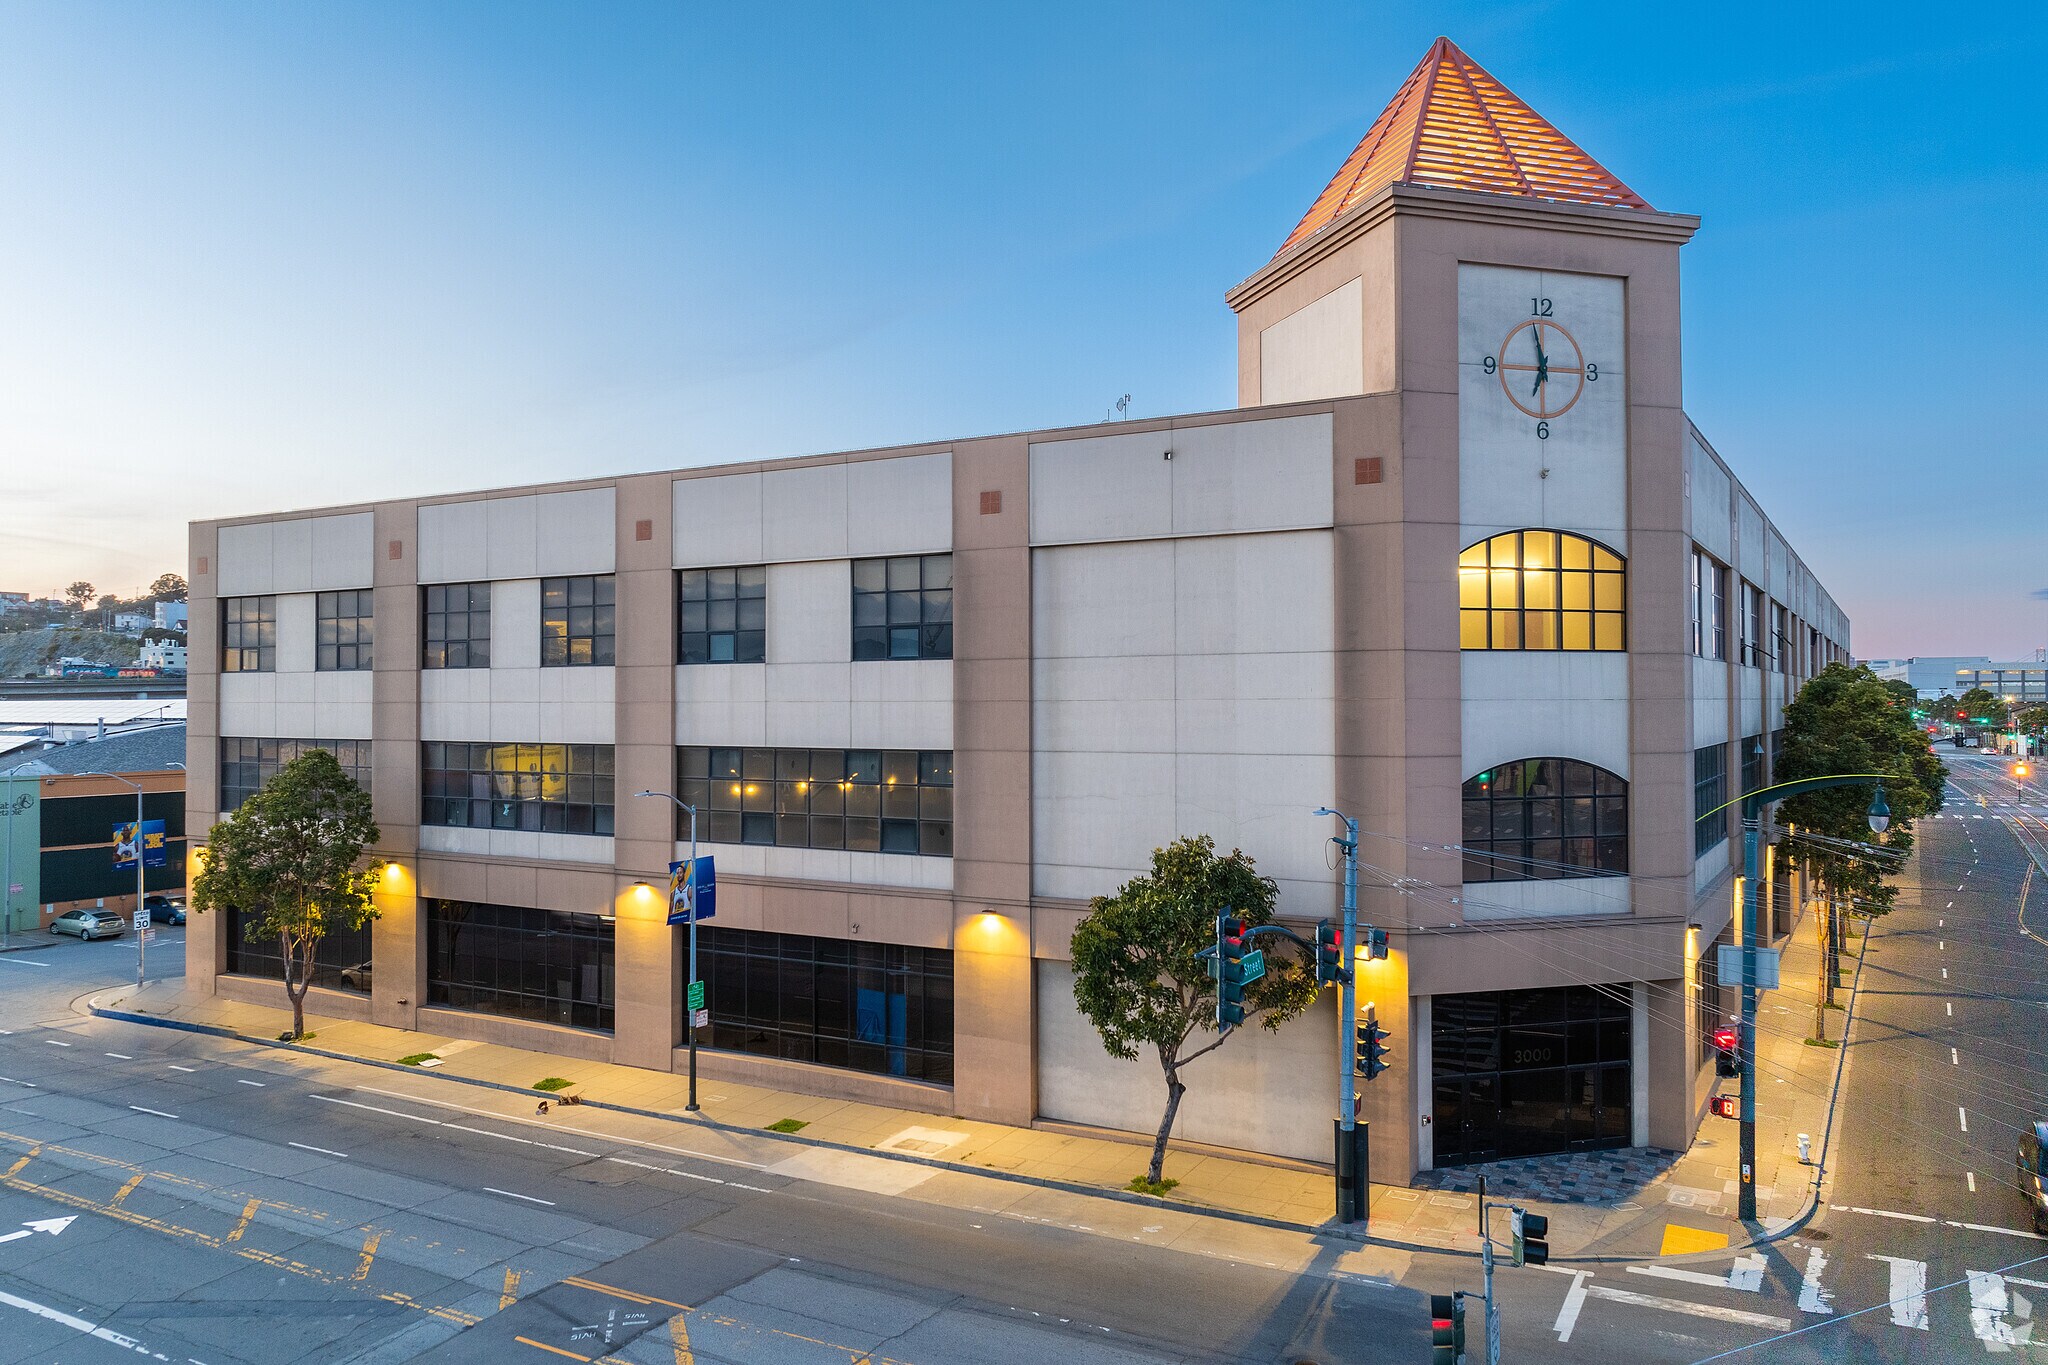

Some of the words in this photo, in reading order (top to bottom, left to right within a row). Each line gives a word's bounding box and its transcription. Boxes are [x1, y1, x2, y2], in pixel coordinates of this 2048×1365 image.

[1531, 298, 1553, 317] 12
[1483, 356, 1496, 374] 9
[1586, 363, 1598, 381] 3
[1536, 421, 1549, 439] 6
[136, 920, 148, 928] 30
[1244, 957, 1261, 976] Street
[1514, 1048, 1551, 1064] 3000
